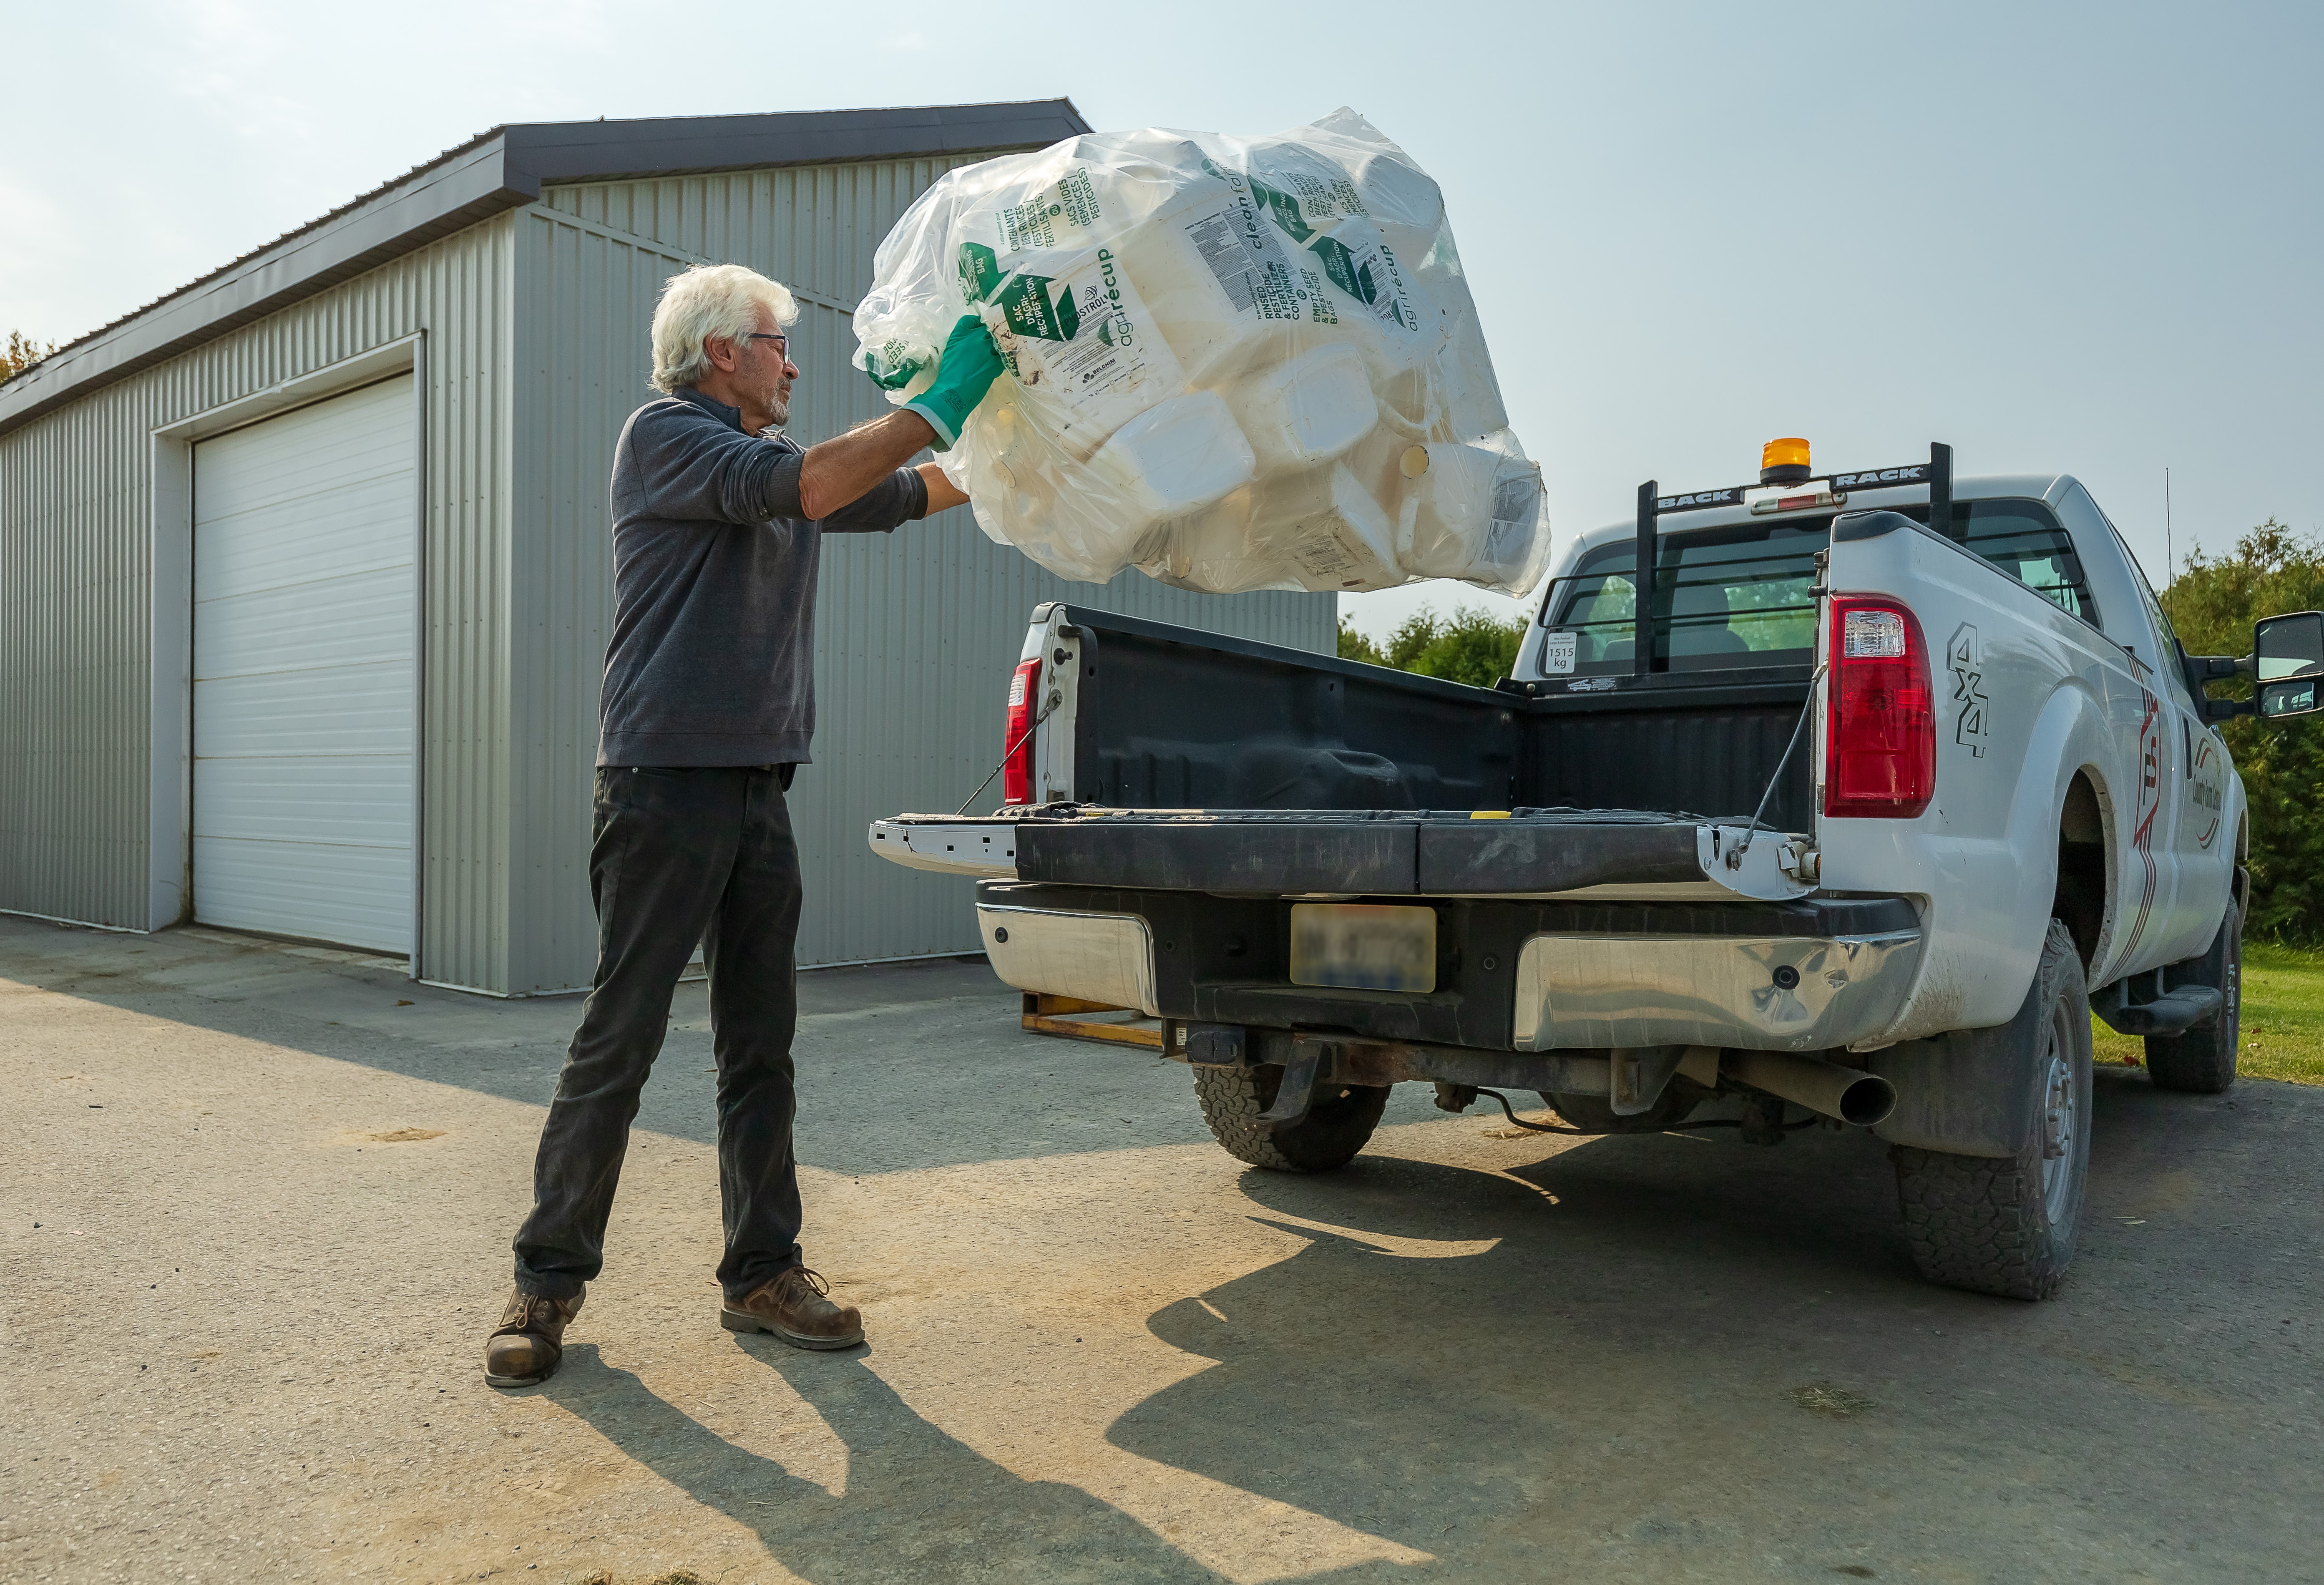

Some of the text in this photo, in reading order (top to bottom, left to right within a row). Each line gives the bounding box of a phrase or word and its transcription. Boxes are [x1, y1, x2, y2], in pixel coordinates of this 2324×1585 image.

[1058, 179, 1079, 227] SACS VIDES
[1071, 180, 1092, 226] (SEMENCES
[1077, 167, 1101, 220] PESTICIDES)
[1286, 172, 1316, 217] CONTENANTS
[1305, 177, 1330, 218] PESTICIDES
[1310, 176, 1344, 221] FRTILISANTS)
[1312, 196, 1322, 216] BIEN
[1328, 179, 1343, 199] VIDES
[1339, 185, 1361, 216] EMENCES
[1343, 181, 1370, 218] ESTICIDES)
[1026, 204, 1044, 247] (PESTICIDES
[1034, 192, 1055, 247] FERTILISANTS)
[1051, 205, 1059, 214] OU
[1277, 207, 1283, 217] AG
[1280, 194, 1296, 232] RECYCLING
[1287, 209, 1297, 223] BAG
[1003, 209, 1020, 251] CONTENANTS
[1021, 232, 1031, 245] BIEN
[975, 258, 985, 274] BAG
[1333, 241, 1353, 292] RÉCUPÉRATION
[1098, 249, 1133, 346] agrirécup
[1257, 287, 1274, 319] RINSED
[1262, 273, 1283, 319] PESTICIDE
[1267, 261, 1290, 310] FERTILIZER
[1276, 264, 1300, 320] CONTAINERS
[1298, 290, 1305, 299] OR
[1300, 268, 1320, 322] EMPTY SEED
[1308, 271, 1329, 314] PESTICIDE
[1380, 245, 1418, 331] agrirécup
[1013, 304, 1024, 321] SAC
[1326, 300, 1338, 324] BAGS
[888, 343, 905, 364] SEED
[1006, 351, 1020, 377] BAGS
[1092, 358, 1116, 375] BELCHIM
[1657, 467, 1921, 508] BACK RACK
[1549, 648, 1574, 657] 1515
[1554, 658, 1567, 669] kg
